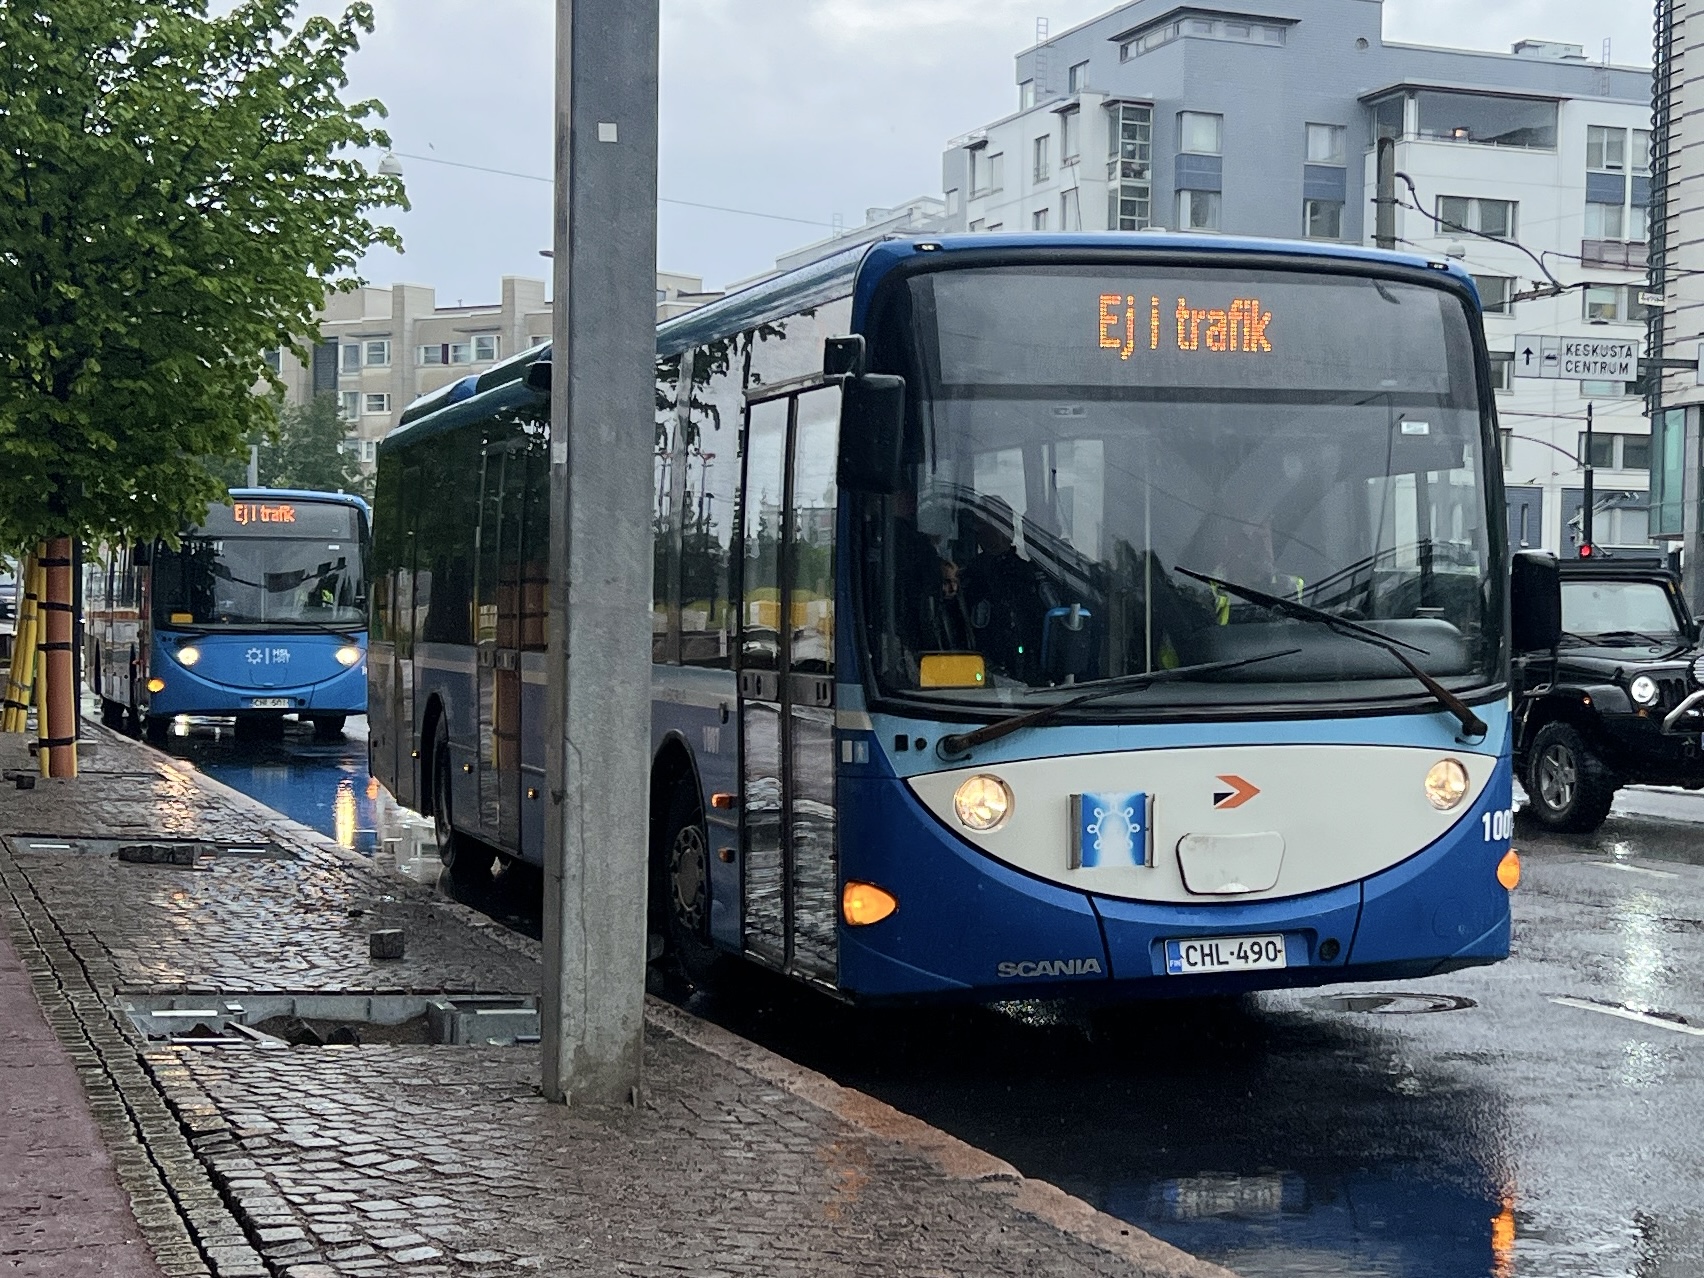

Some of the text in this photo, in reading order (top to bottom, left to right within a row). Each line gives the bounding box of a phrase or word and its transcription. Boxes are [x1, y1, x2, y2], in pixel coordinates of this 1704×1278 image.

[1099, 295, 1134, 360] Ej
[1175, 297, 1272, 352] trafik
[1565, 343, 1632, 359] KESKUSTA
[1565, 360, 1629, 375] CENTRUM
[234, 504, 248, 525] Ej
[1185, 940, 1279, 967] CHL-490
[998, 958, 1102, 977] SCANIA
